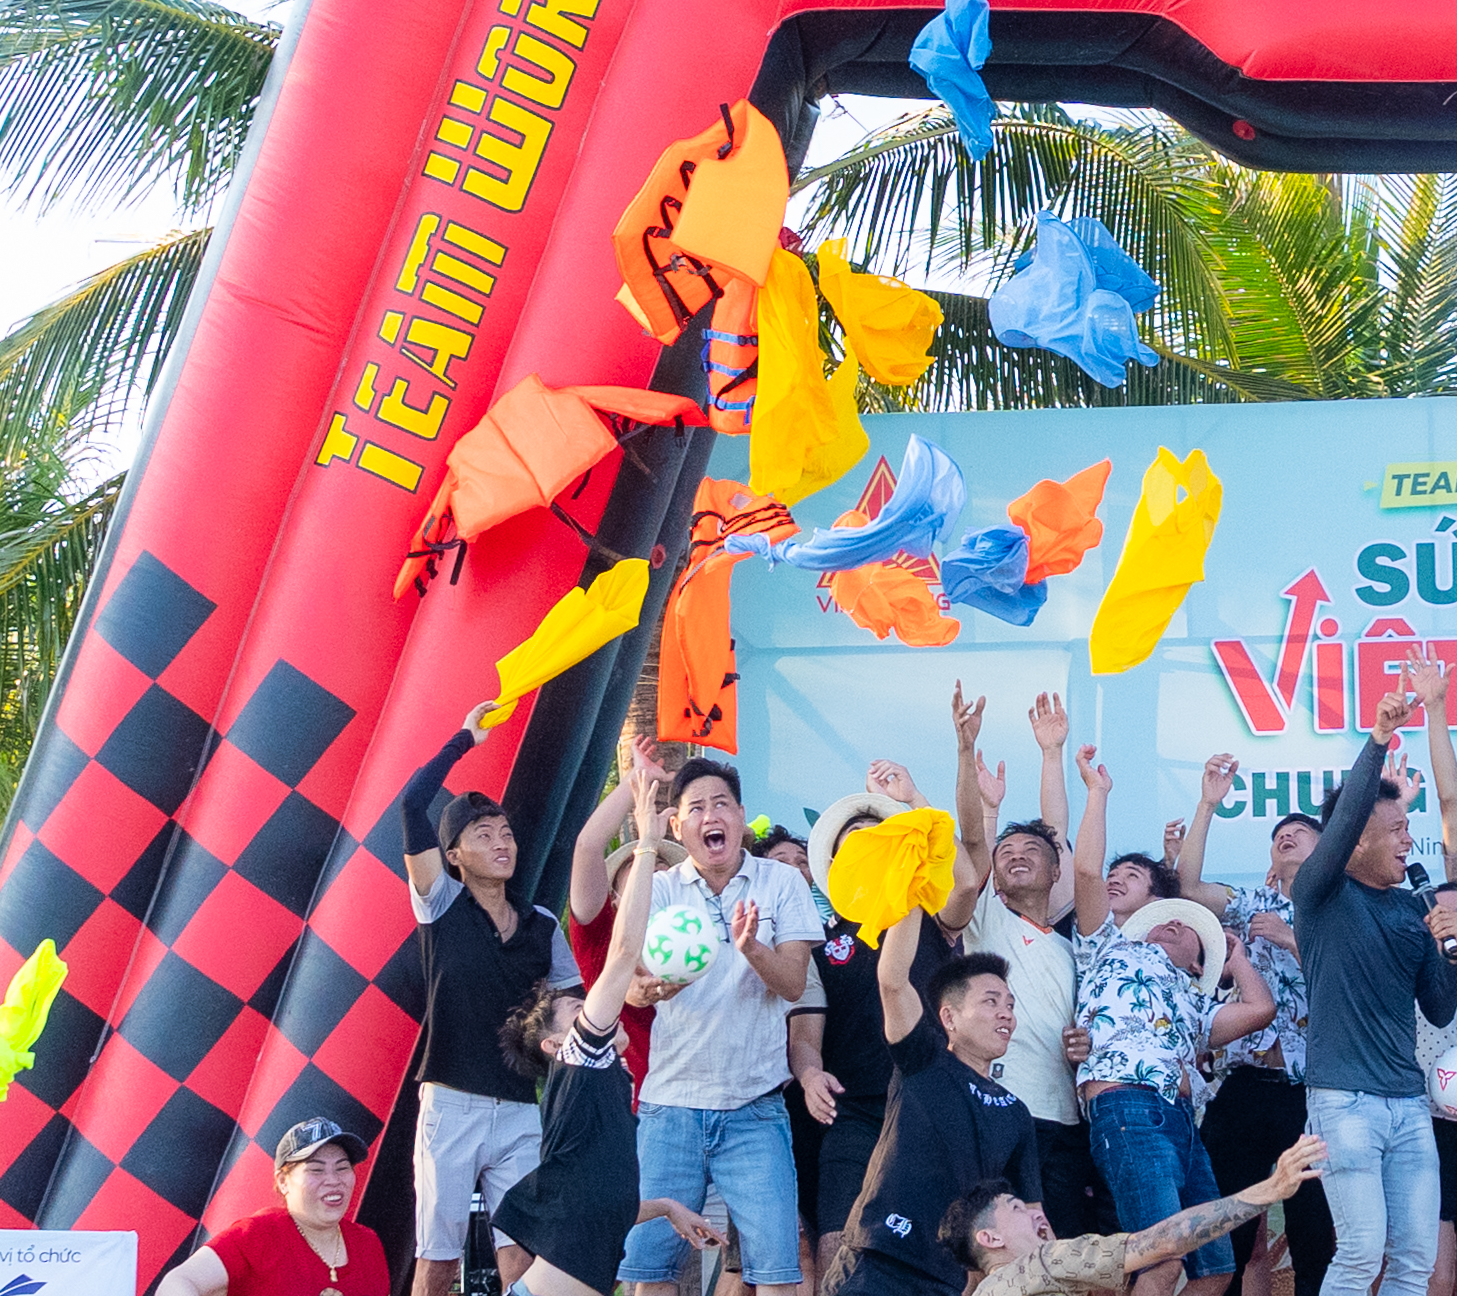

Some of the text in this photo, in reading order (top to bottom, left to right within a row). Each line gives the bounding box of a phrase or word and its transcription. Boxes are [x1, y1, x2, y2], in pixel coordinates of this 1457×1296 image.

[315, 213, 508, 494] TEAM
[1215, 767, 1426, 818] CHUG
[1411, 837, 1443, 856] Nin
[0, 1248, 13, 1266] vị
[17, 1244, 35, 1263] tổ
[39, 1248, 81, 1263] chức
